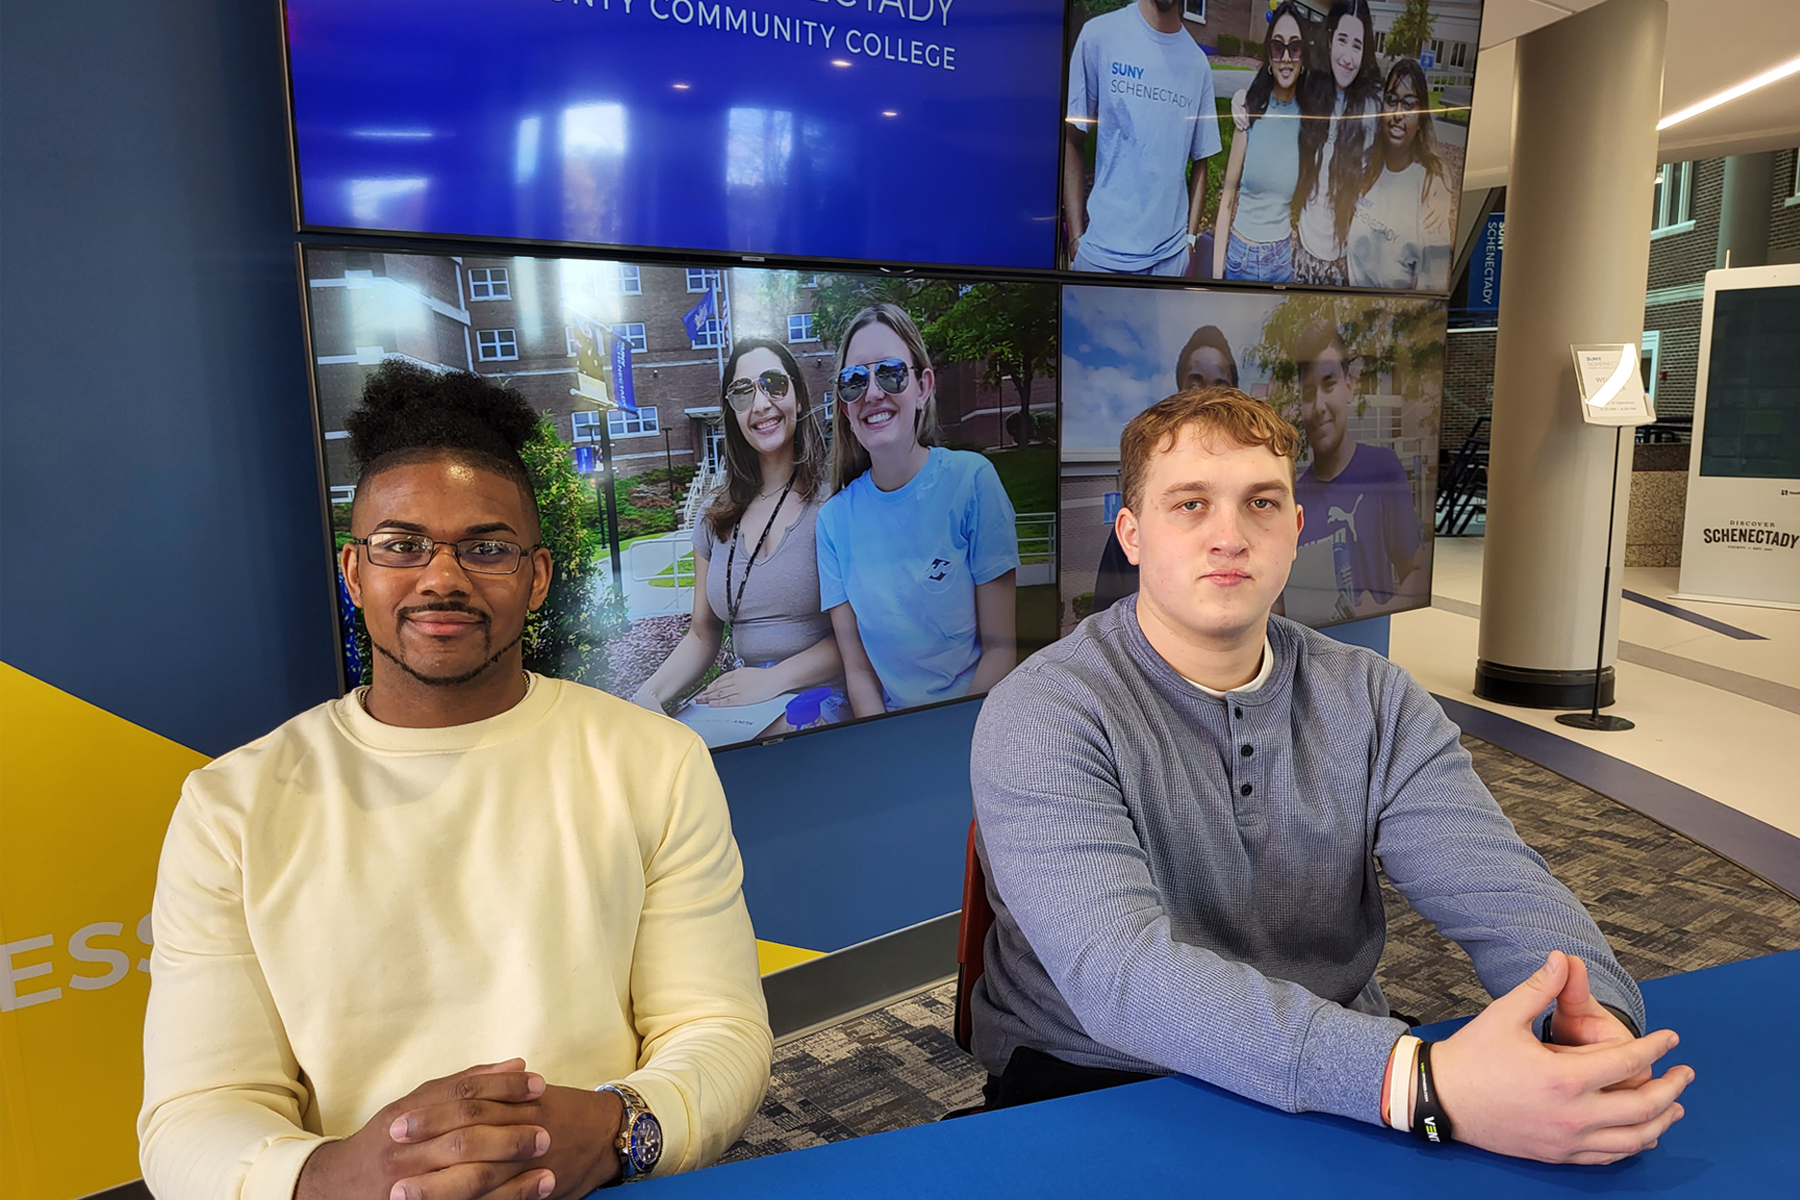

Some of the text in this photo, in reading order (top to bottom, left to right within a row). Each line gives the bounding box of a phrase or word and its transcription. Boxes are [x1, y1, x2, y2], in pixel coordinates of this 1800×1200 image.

[650, 0, 956, 70] COMMUNITY COLLEGE
[1111, 61, 1144, 80] SUNY
[1110, 79, 1193, 109] SCHENECTADY
[1482, 221, 1498, 305] SCHENECTADY
[1730, 519, 1775, 527] DISCOVER
[1703, 528, 1799, 549] SCHENECTADY
[1424, 1116, 1441, 1143] VENT
